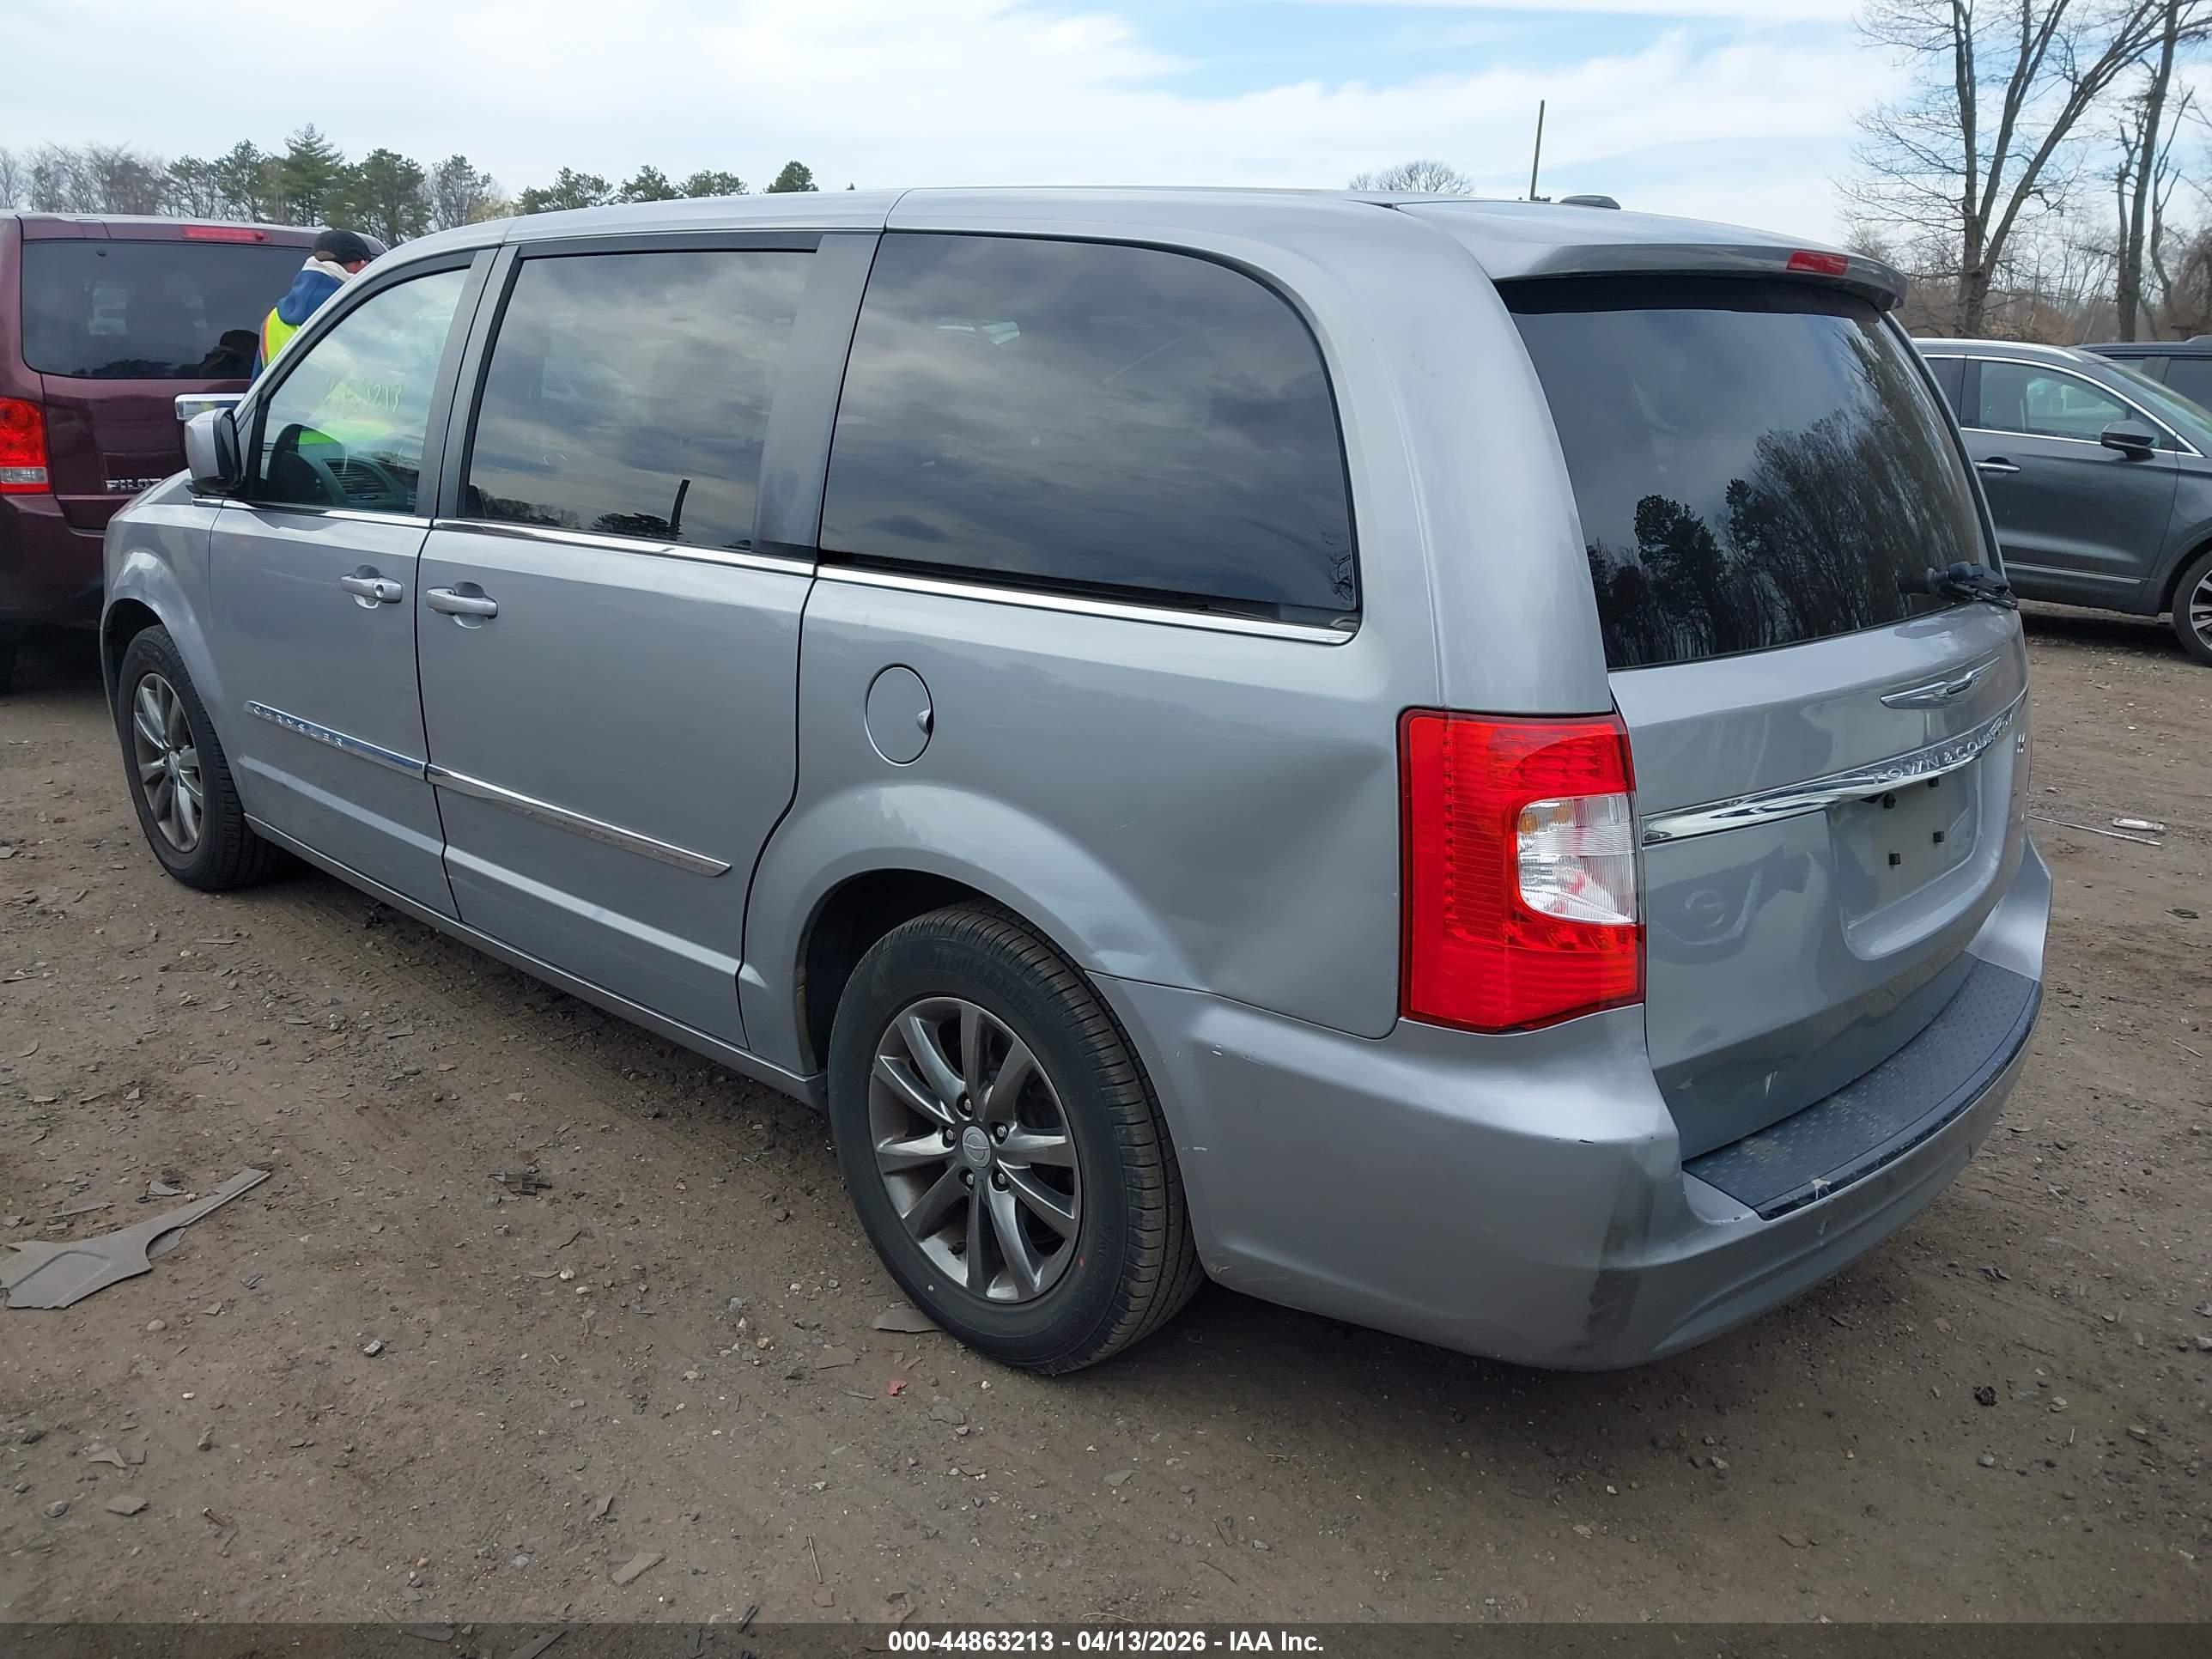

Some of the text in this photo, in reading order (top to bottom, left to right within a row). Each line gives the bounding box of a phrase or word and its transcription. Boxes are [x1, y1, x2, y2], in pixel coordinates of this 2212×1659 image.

[252, 705, 343, 748] CHRYSLER
[1870, 754, 1941, 785] TOWN
[1943, 750, 1954, 764] &
